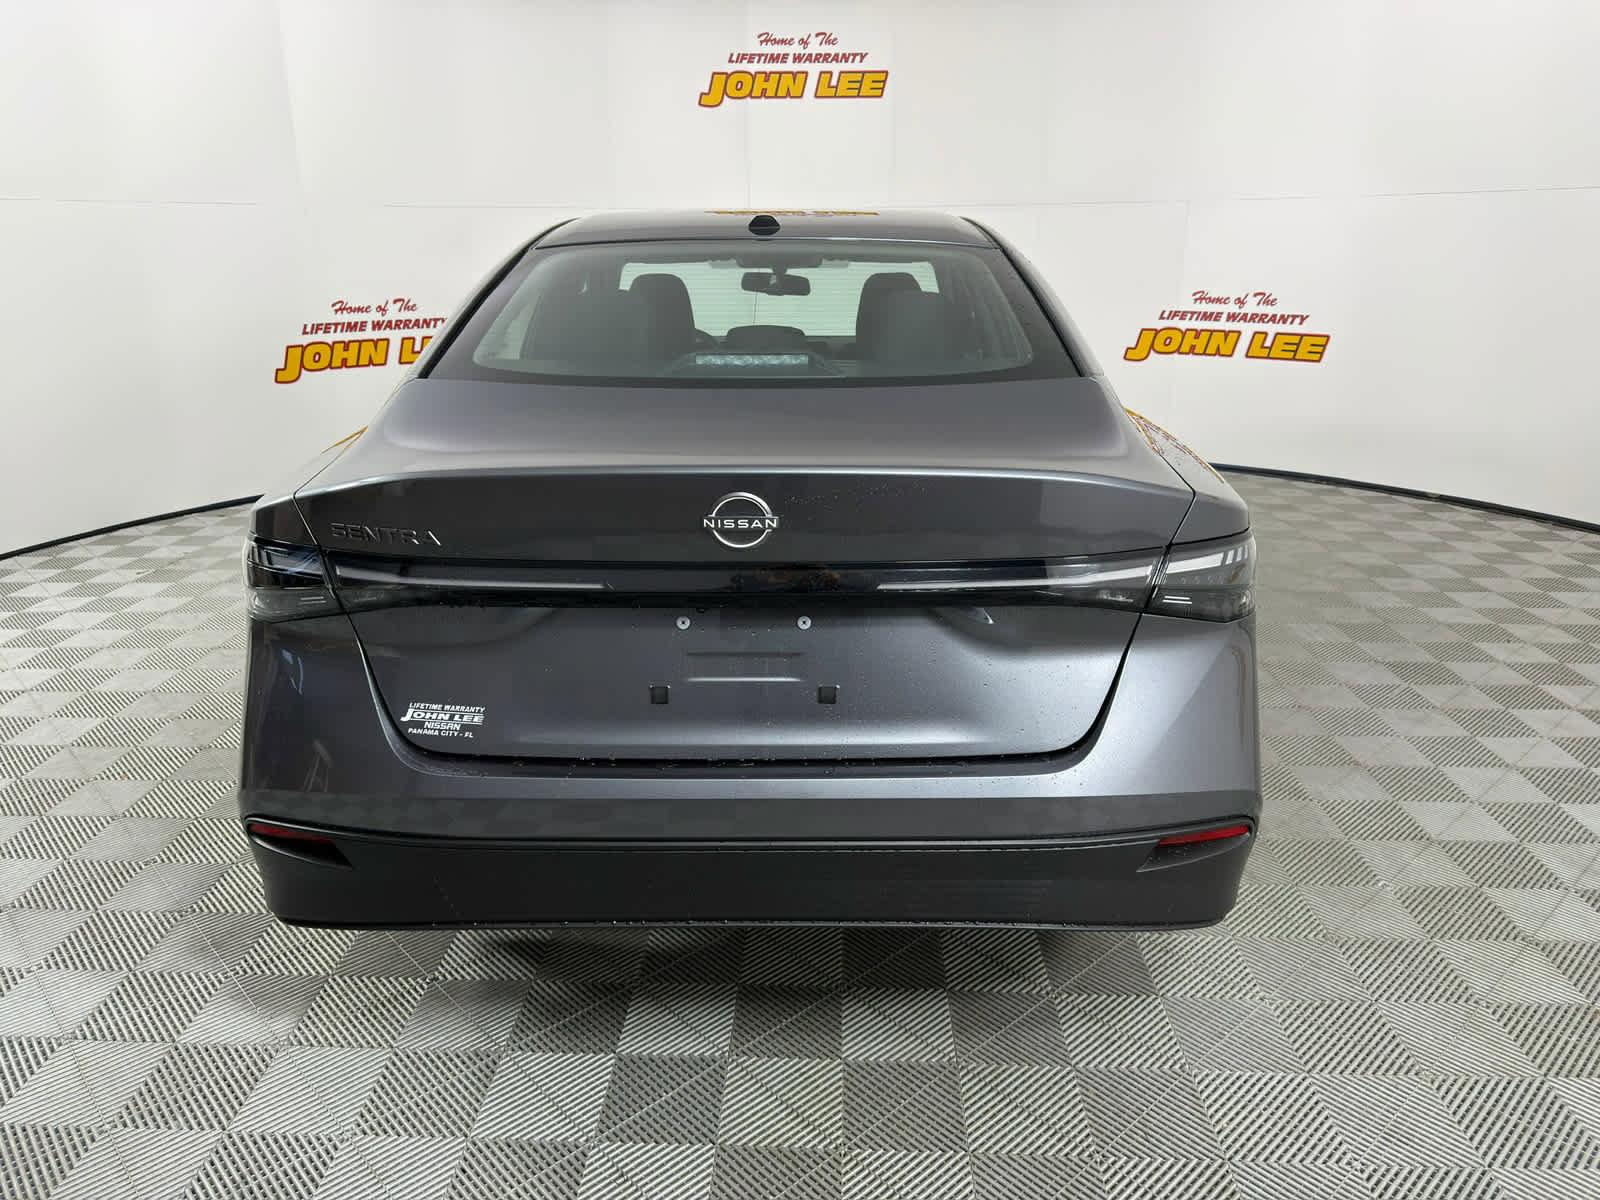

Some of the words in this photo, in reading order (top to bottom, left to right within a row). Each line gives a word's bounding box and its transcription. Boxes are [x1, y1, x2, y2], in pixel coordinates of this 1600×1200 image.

[757, 31, 795, 47] Home
[798, 32, 811, 49] of
[815, 31, 839, 47] The
[728, 52, 790, 64] LIFETIME
[792, 52, 868, 64] WARRANTY
[698, 70, 808, 108] JOHN
[814, 70, 888, 98] LEE
[1192, 290, 1230, 305] Home
[1234, 293, 1249, 309] of
[1253, 291, 1278, 307] The
[331, 300, 372, 315] Home
[375, 300, 390, 317] of
[393, 298, 417, 313] The
[1158, 310, 1223, 322] LIFETIME
[1225, 311, 1309, 325] WARRANTY
[302, 321, 369, 335] LIFETIME
[1123, 326, 1241, 362] JOHN
[1245, 331, 1330, 363] LEE
[275, 338, 390, 384] JOHN
[703, 518, 778, 529] NISSAN
[330, 522, 442, 546] SENTRA
[408, 702, 443, 710] LIFETIME
[444, 704, 486, 713] WARRANTY
[400, 708, 450, 721] JOHN
[453, 713, 485, 723] LEE
[407, 727, 439, 736] PANAMA
[441, 729, 459, 737] CITY
[424, 721, 462, 731] NISSAN
